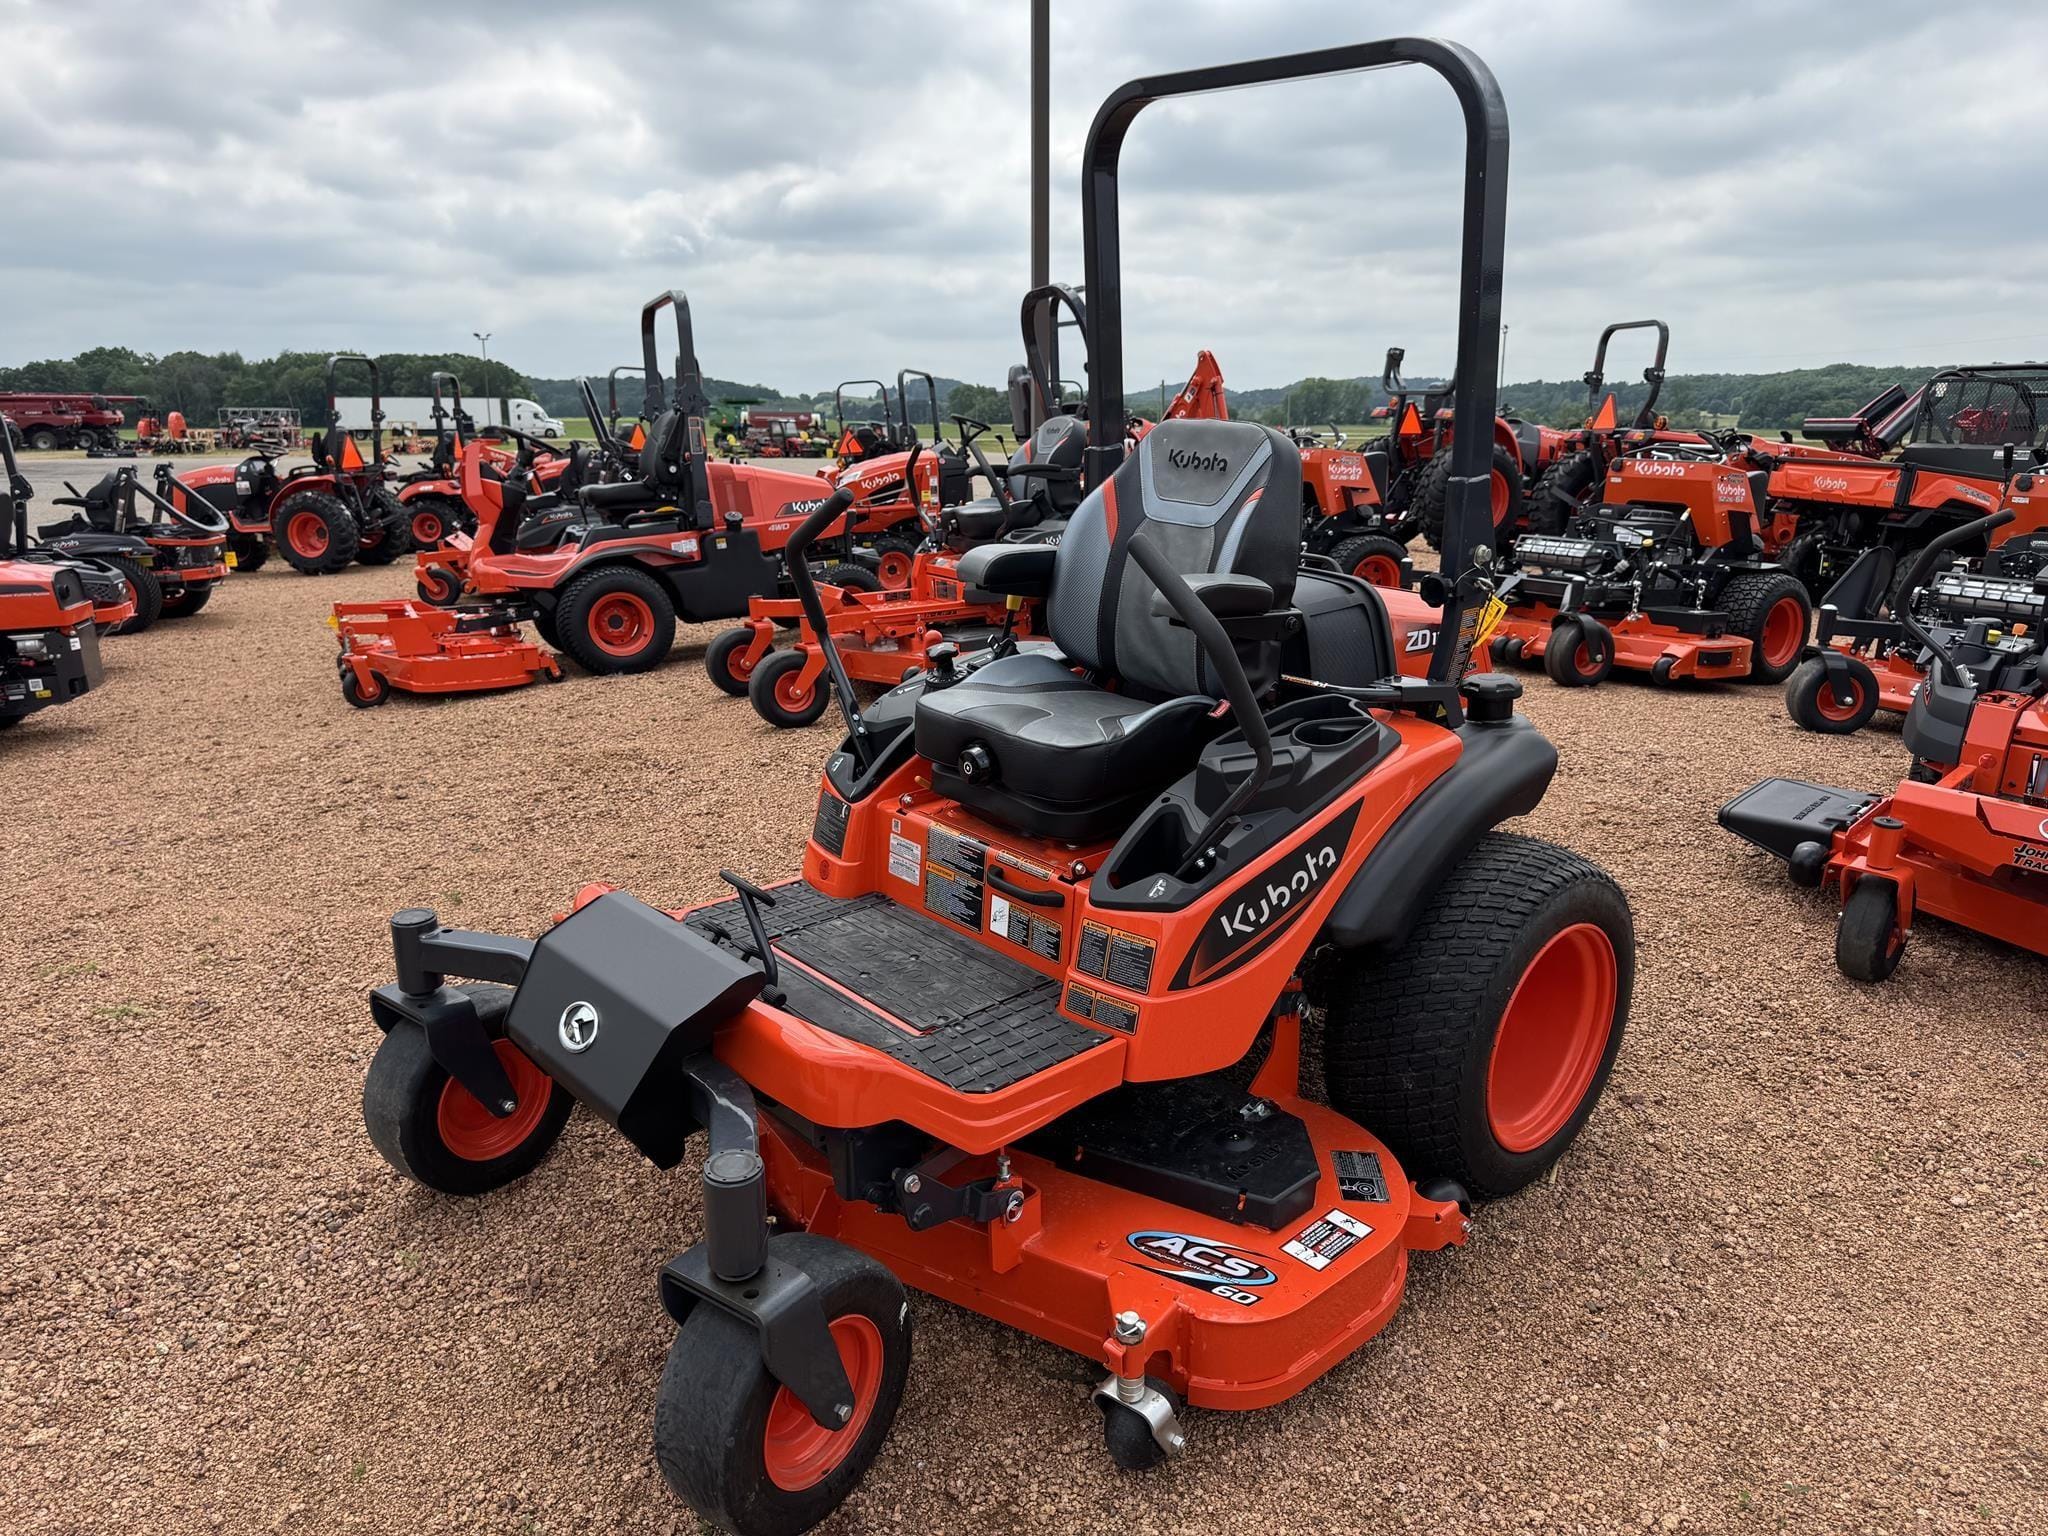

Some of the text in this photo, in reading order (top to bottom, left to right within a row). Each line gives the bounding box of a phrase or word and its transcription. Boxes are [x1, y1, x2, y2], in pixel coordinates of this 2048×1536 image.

[1168, 449, 1228, 473] Kubota
[1634, 461, 1685, 476] Kubota
[1328, 464, 1362, 475] Kubota
[861, 472, 900, 489] Kubota
[1814, 476, 1847, 490] Kubota
[1717, 483, 1745, 496] Kubota
[768, 523, 790, 531] 4WD
[1220, 846, 1337, 937] Kubota
[1104, 996, 1135, 1010] ADVERTENCIA
[1147, 1237, 1260, 1277] ACS
[1211, 1285, 1259, 1305] 60
